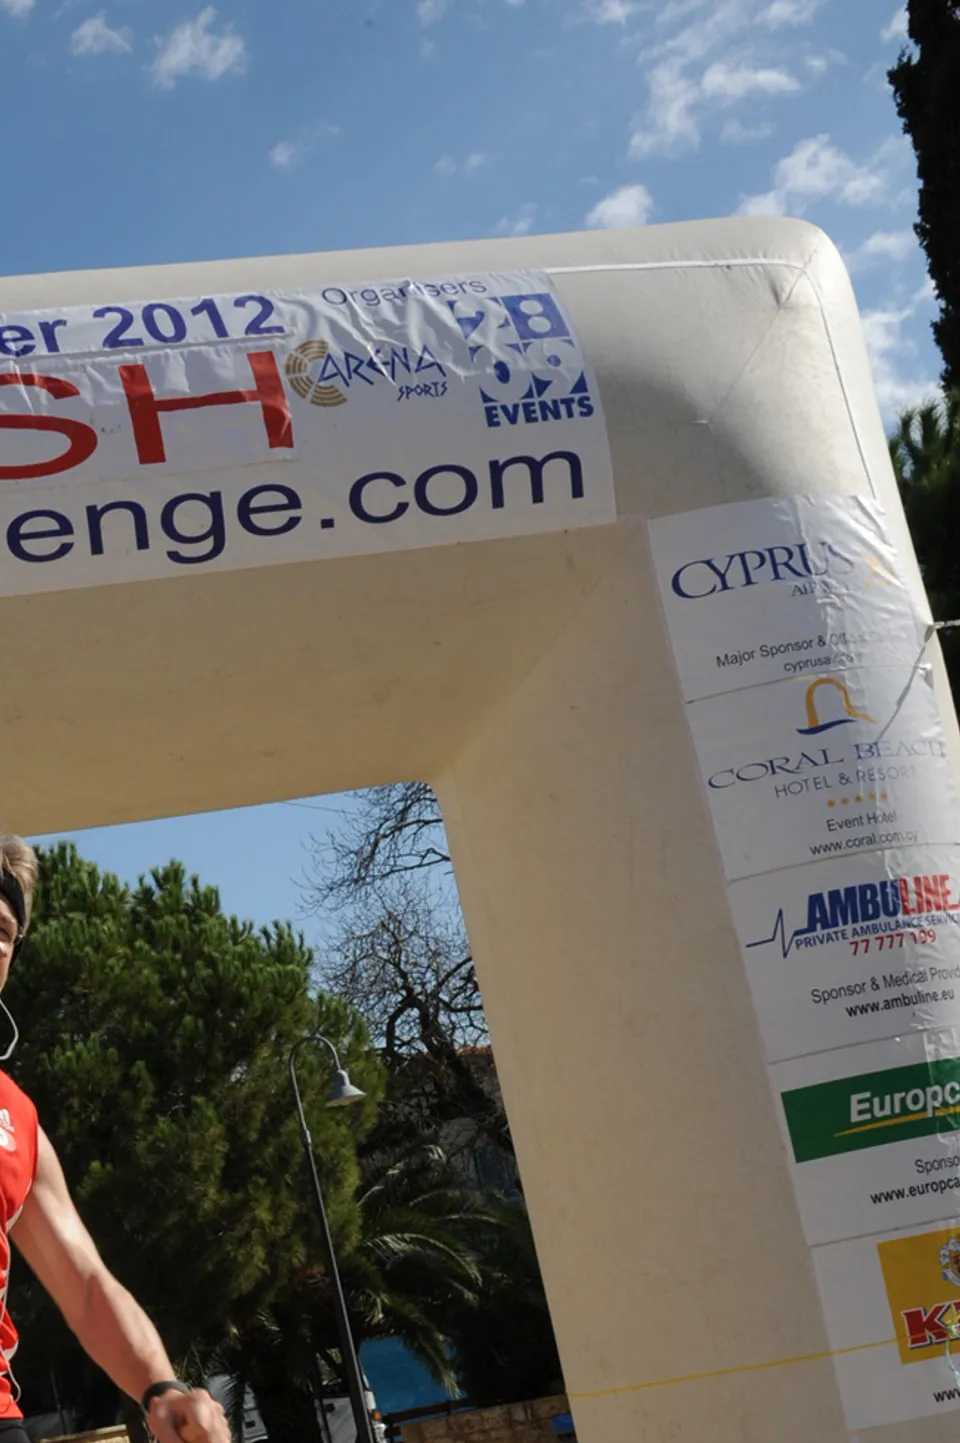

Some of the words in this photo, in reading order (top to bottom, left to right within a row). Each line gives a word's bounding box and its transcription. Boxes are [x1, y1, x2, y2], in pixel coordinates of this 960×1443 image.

[92, 294, 287, 350] 2012
[397, 381, 448, 402] SPORTS
[484, 395, 594, 428] EVENTS
[671, 541, 854, 599] CYPRUS
[716, 650, 756, 668] Major
[760, 639, 813, 658] Sponsor
[817, 634, 827, 648] &
[708, 748, 844, 789] CORAL
[774, 775, 832, 799] HOTEL
[838, 771, 852, 787] &
[826, 812, 863, 832] Event
[866, 811, 897, 827] Hotel
[806, 874, 960, 932] AMBULINE
[795, 929, 849, 949] PRIVATE
[852, 917, 924, 939] AMBULANCE
[849, 939, 870, 956] 77
[875, 932, 904, 951] 777
[811, 981, 866, 1004] Sponsor
[870, 976, 880, 991] &
[882, 969, 928, 989] Medical
[846, 988, 955, 1017] www.ambuline.eu
[850, 1080, 960, 1123] Europc
